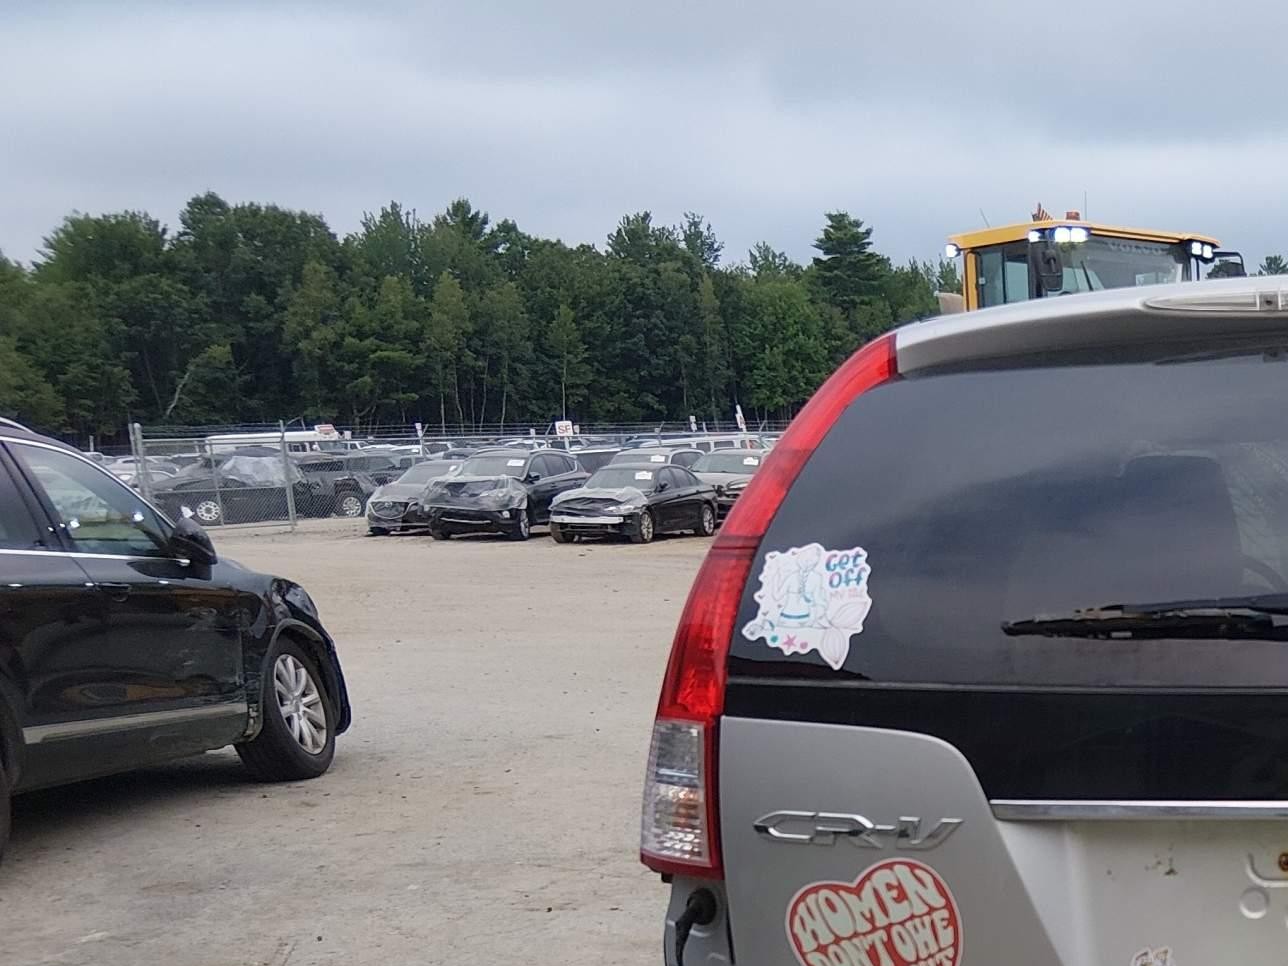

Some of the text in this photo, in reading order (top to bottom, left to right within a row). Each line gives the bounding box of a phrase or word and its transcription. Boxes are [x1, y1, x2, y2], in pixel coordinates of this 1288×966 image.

[753, 810, 964, 850] CR-V
[793, 864, 946, 953] WOMEN
[891, 910, 955, 962] OWE
